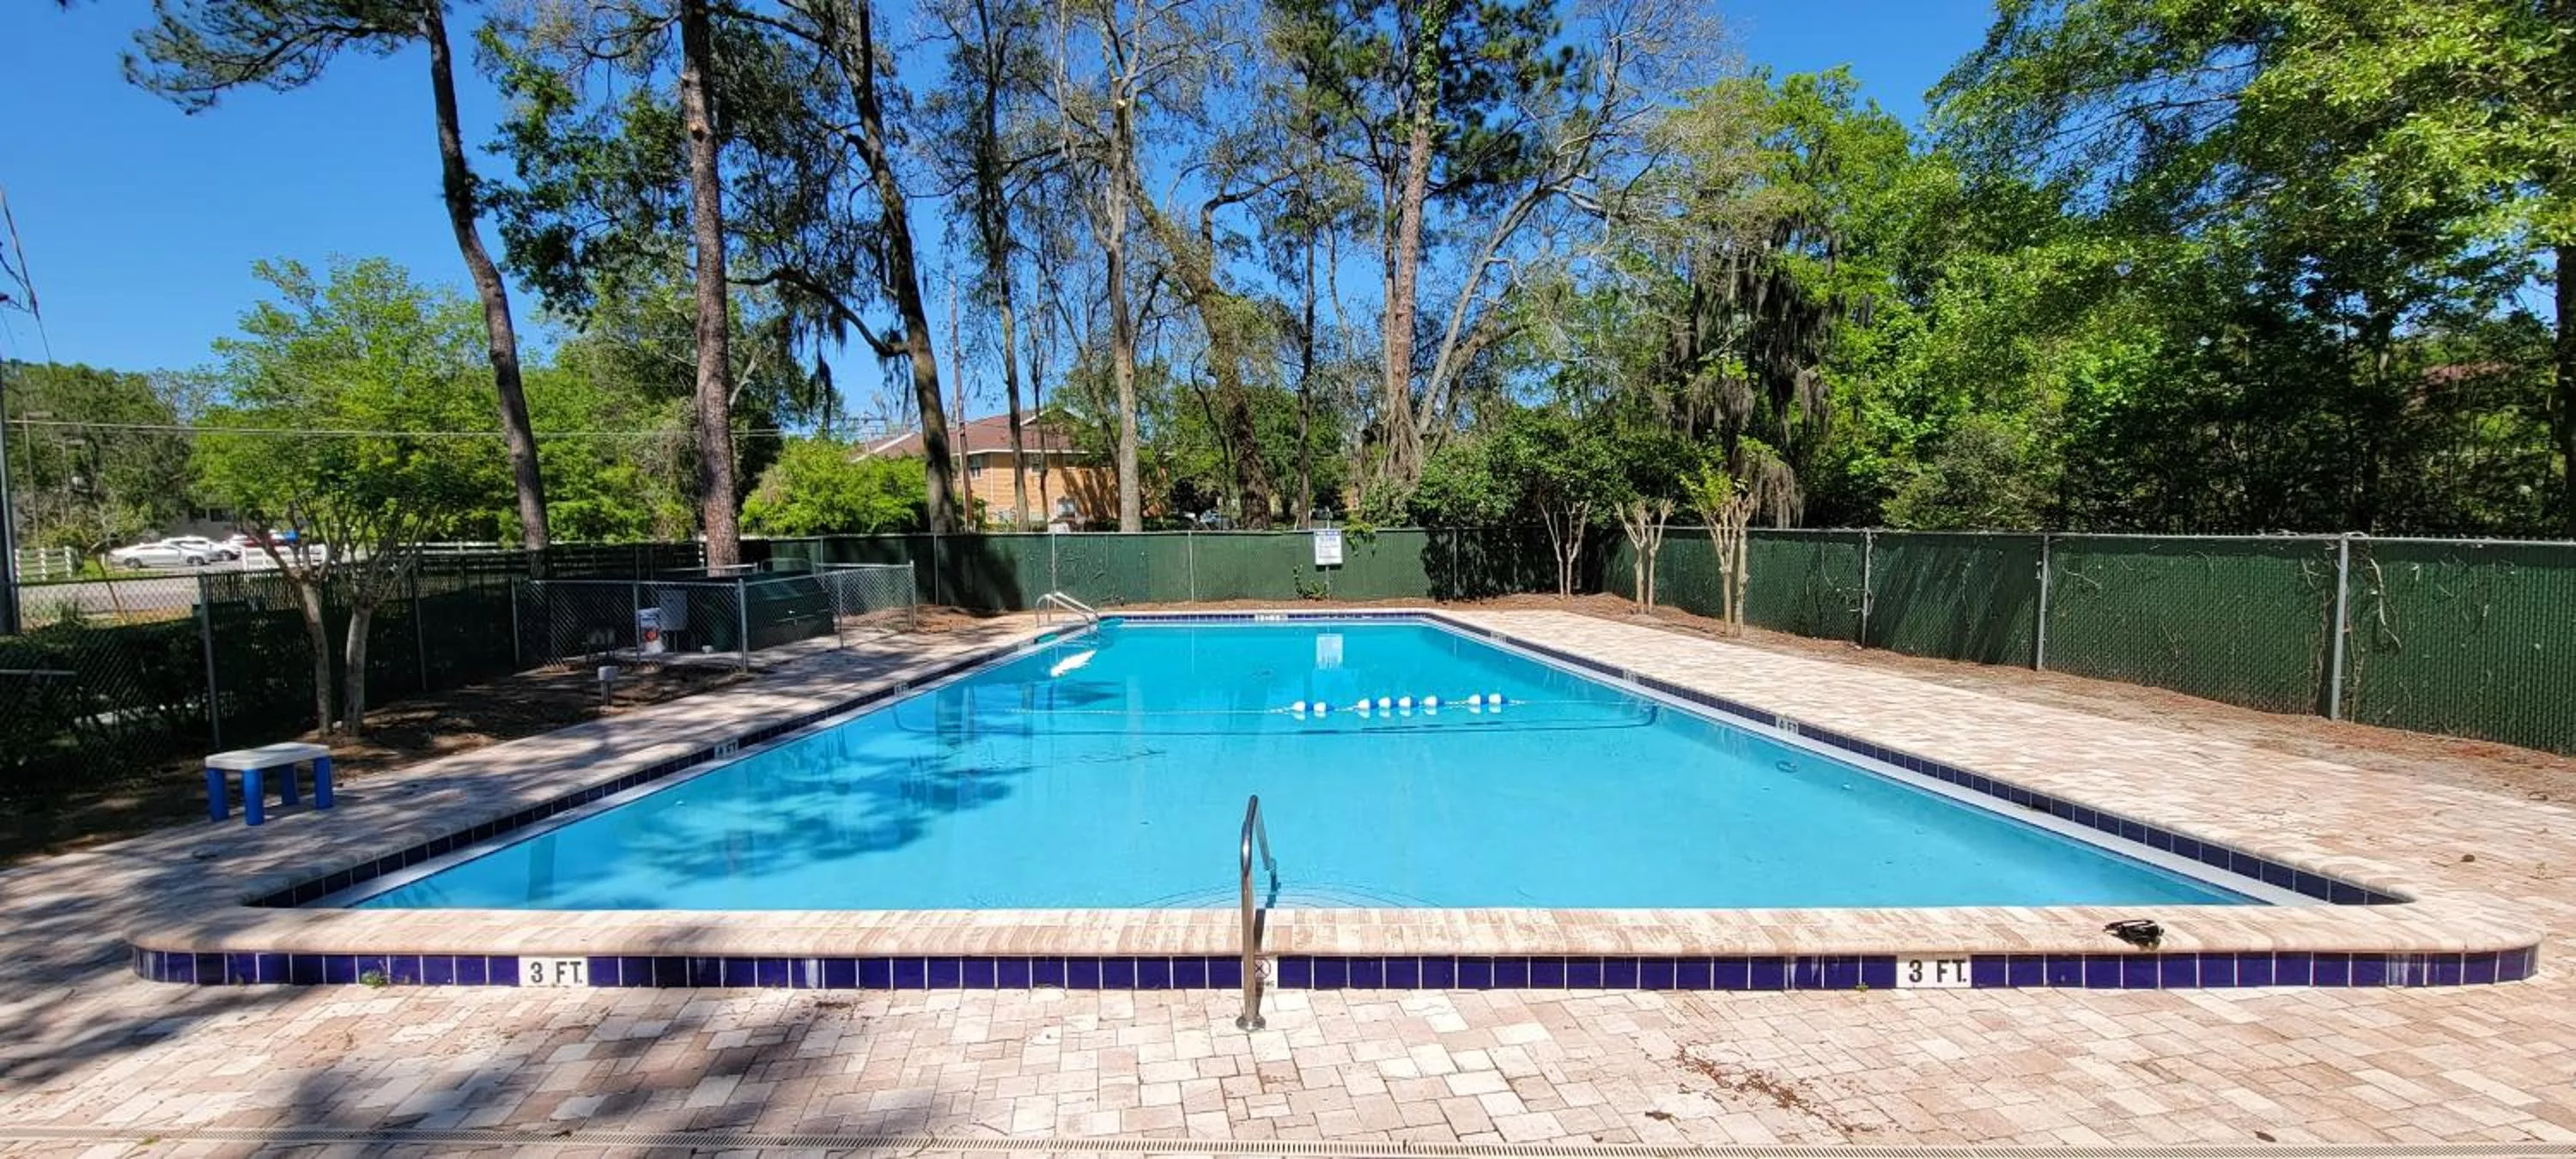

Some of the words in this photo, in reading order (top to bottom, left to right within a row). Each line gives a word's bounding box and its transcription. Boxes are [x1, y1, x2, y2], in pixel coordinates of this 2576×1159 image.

[530, 961, 544, 984] 3
[555, 961, 583, 984] FT.
[1909, 959, 1923, 982] 3
[1936, 959, 1967, 982] FT.
